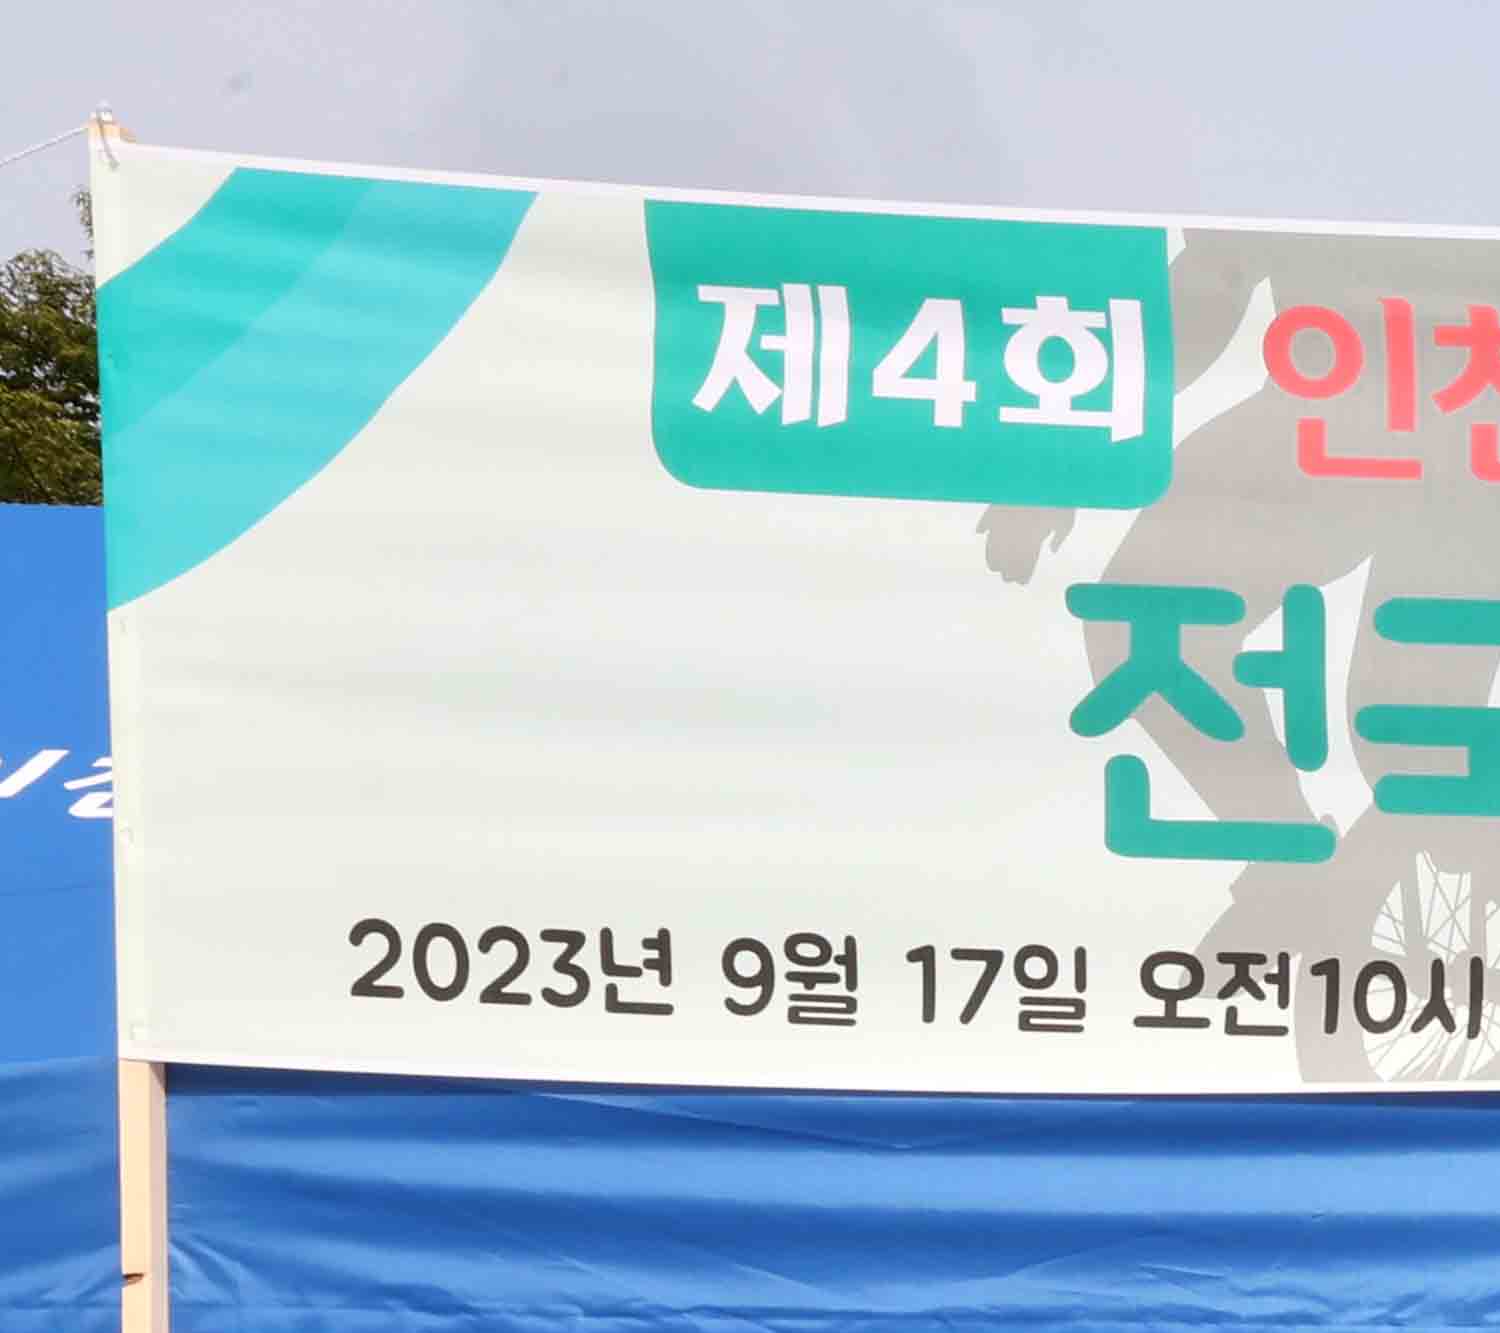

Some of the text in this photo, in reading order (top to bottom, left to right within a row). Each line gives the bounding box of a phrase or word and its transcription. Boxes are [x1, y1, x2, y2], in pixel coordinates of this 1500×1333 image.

[694, 285, 1144, 441] 제4회
[350, 919, 1483, 1038] 2023년 9월 17일 오전10시
